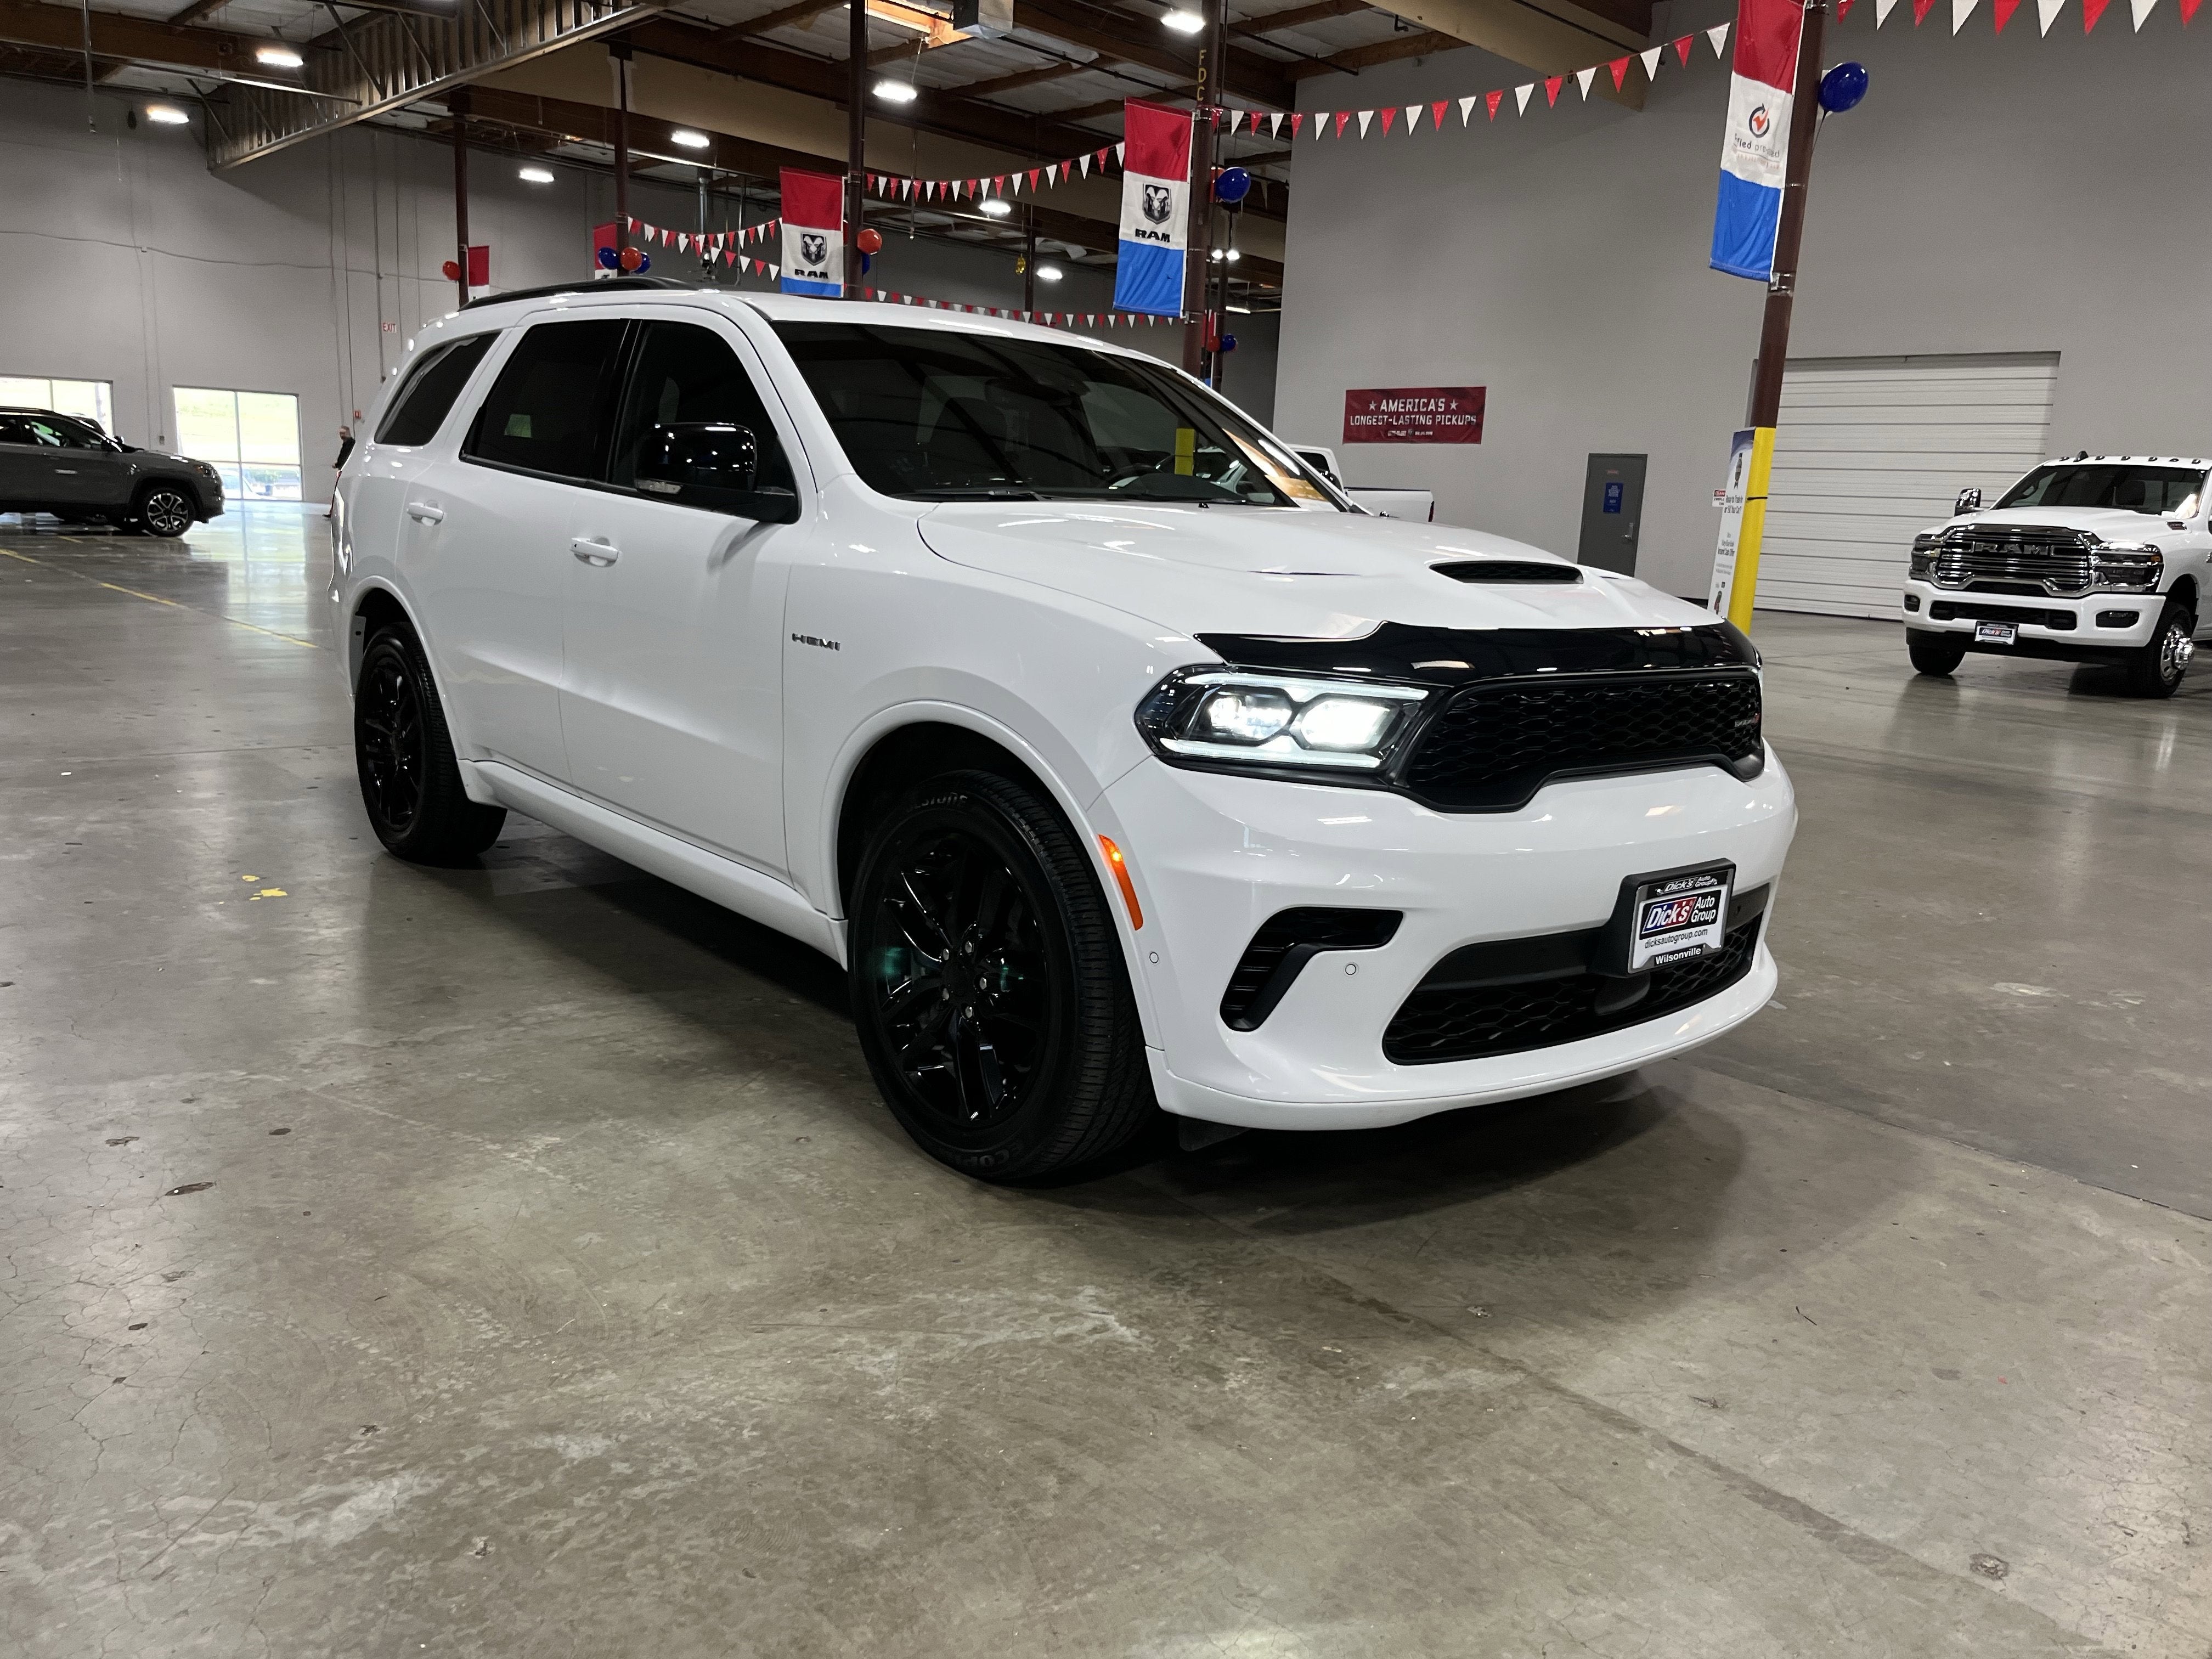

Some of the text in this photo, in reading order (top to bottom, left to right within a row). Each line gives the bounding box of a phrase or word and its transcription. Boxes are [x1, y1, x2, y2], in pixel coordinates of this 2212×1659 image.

[1135, 228, 1170, 242] RAM
[794, 269, 828, 279] RAM
[382, 323, 396, 332] EXIT
[1380, 398, 1445, 412] AMERICA'S
[1350, 415, 1476, 426] LONGEST-LASTING PICKUPS
[1975, 542, 2049, 555] RAM
[792, 633, 840, 651] HEMI
[1664, 879, 1694, 892] Dick's
[1646, 896, 1716, 929] Dick's Auto Group
[1645, 929, 1708, 949] dicksautogroup.com
[1655, 947, 1701, 964] Wilsonville
